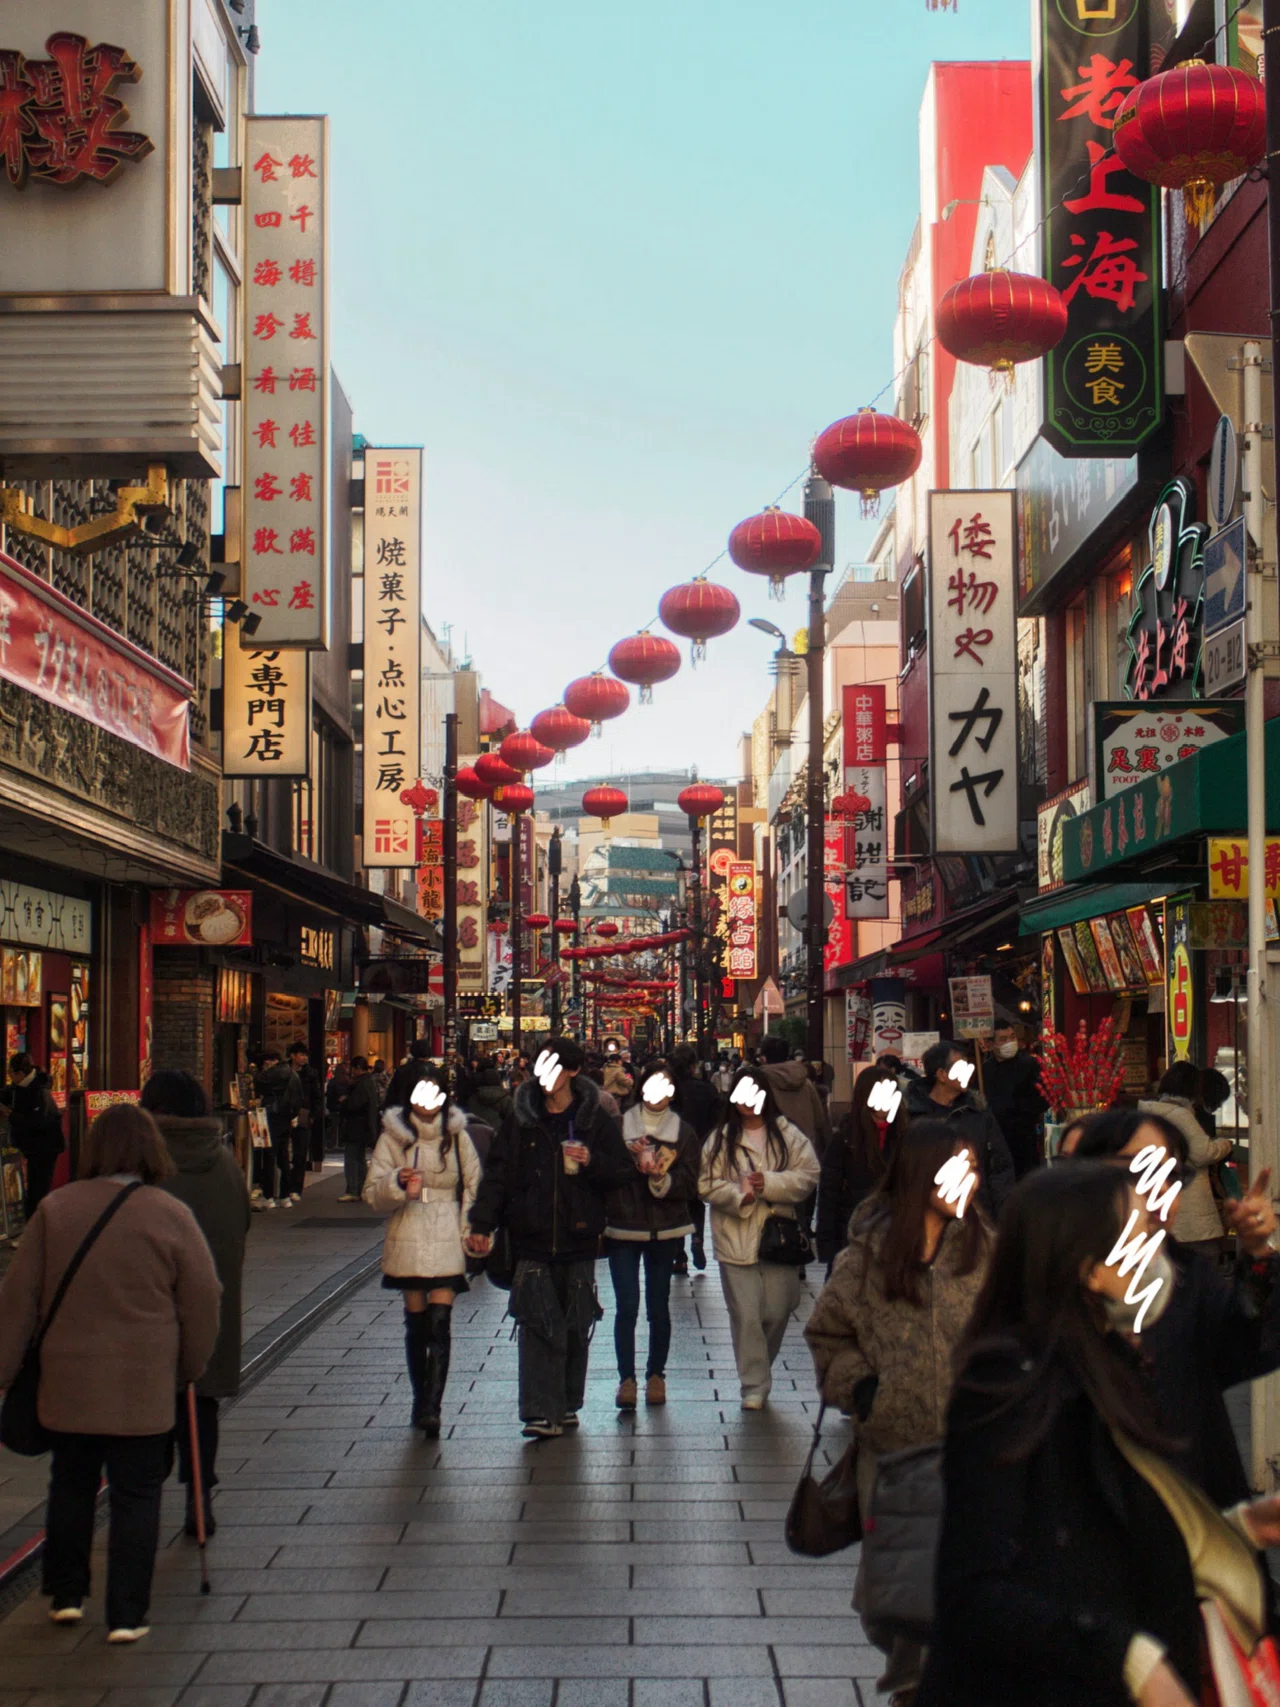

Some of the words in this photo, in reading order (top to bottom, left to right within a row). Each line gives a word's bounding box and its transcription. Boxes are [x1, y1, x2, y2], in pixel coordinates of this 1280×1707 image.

[1056, 53, 1148, 314] 老上海
[1084, 342, 1125, 405] 美食
[948, 512, 997, 666] 倭物や
[375, 536, 407, 793] 焼菓子・点心工房
[854, 694, 873, 762] 中華粥店
[948, 687, 1004, 826] カヤ
[1112, 775, 1141, 784] FOOT
[1134, 727, 1157, 738] 元祖
